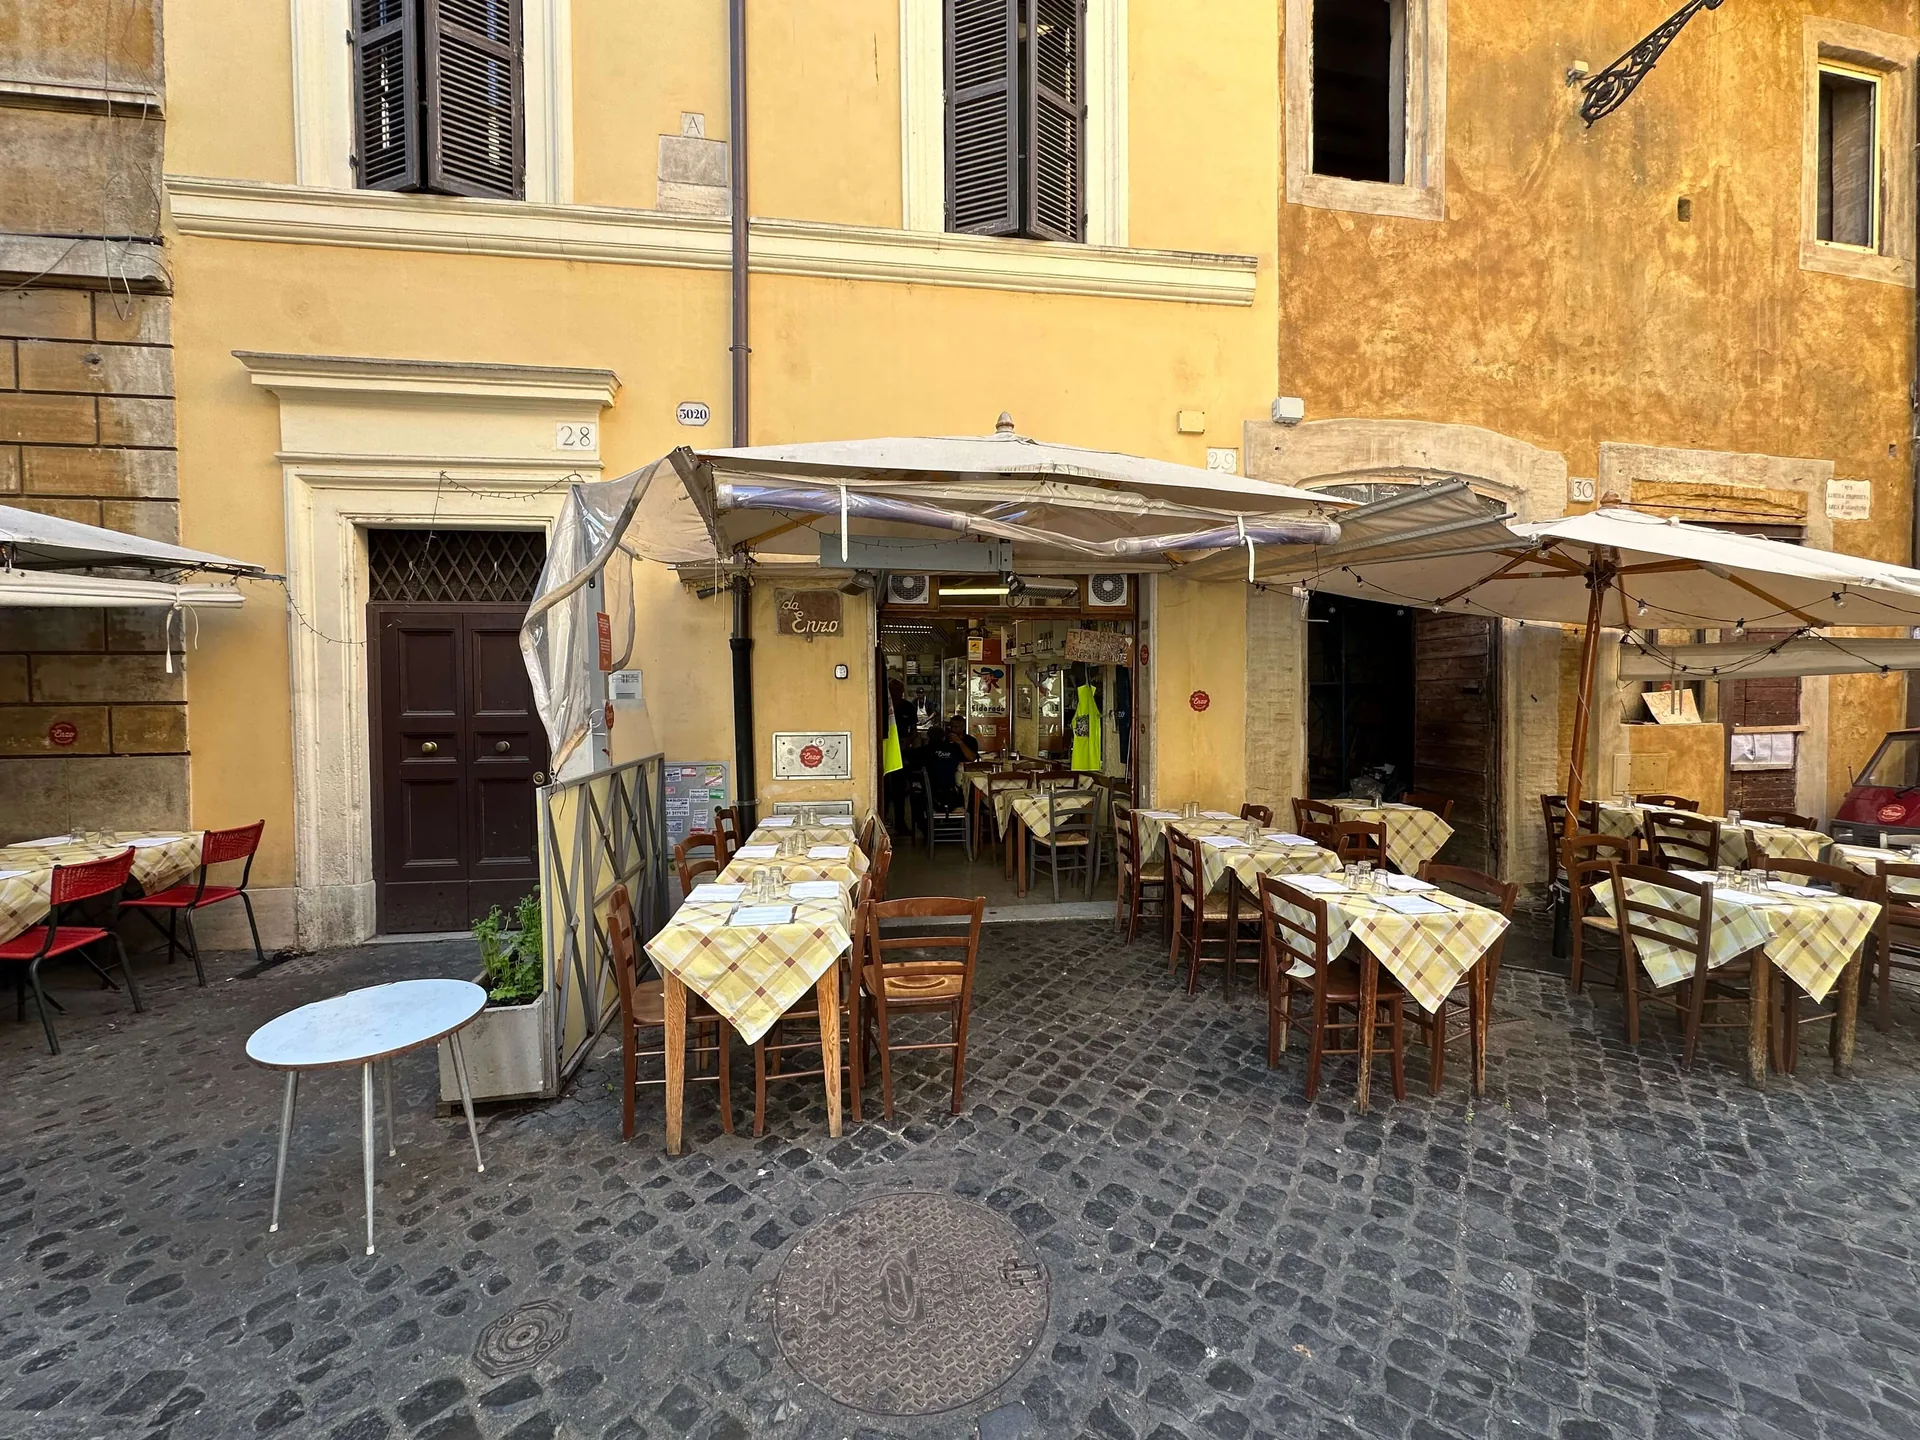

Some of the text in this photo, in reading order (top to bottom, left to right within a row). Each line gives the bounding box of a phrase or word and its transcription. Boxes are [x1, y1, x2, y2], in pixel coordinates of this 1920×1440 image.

[686, 116, 700, 134] A
[679, 408, 707, 420] 3020
[560, 425, 591, 446] 28
[1208, 451, 1235, 470] 29
[1574, 481, 1594, 498] 30
[781, 595, 799, 610] da
[792, 611, 840, 633] Enzo
